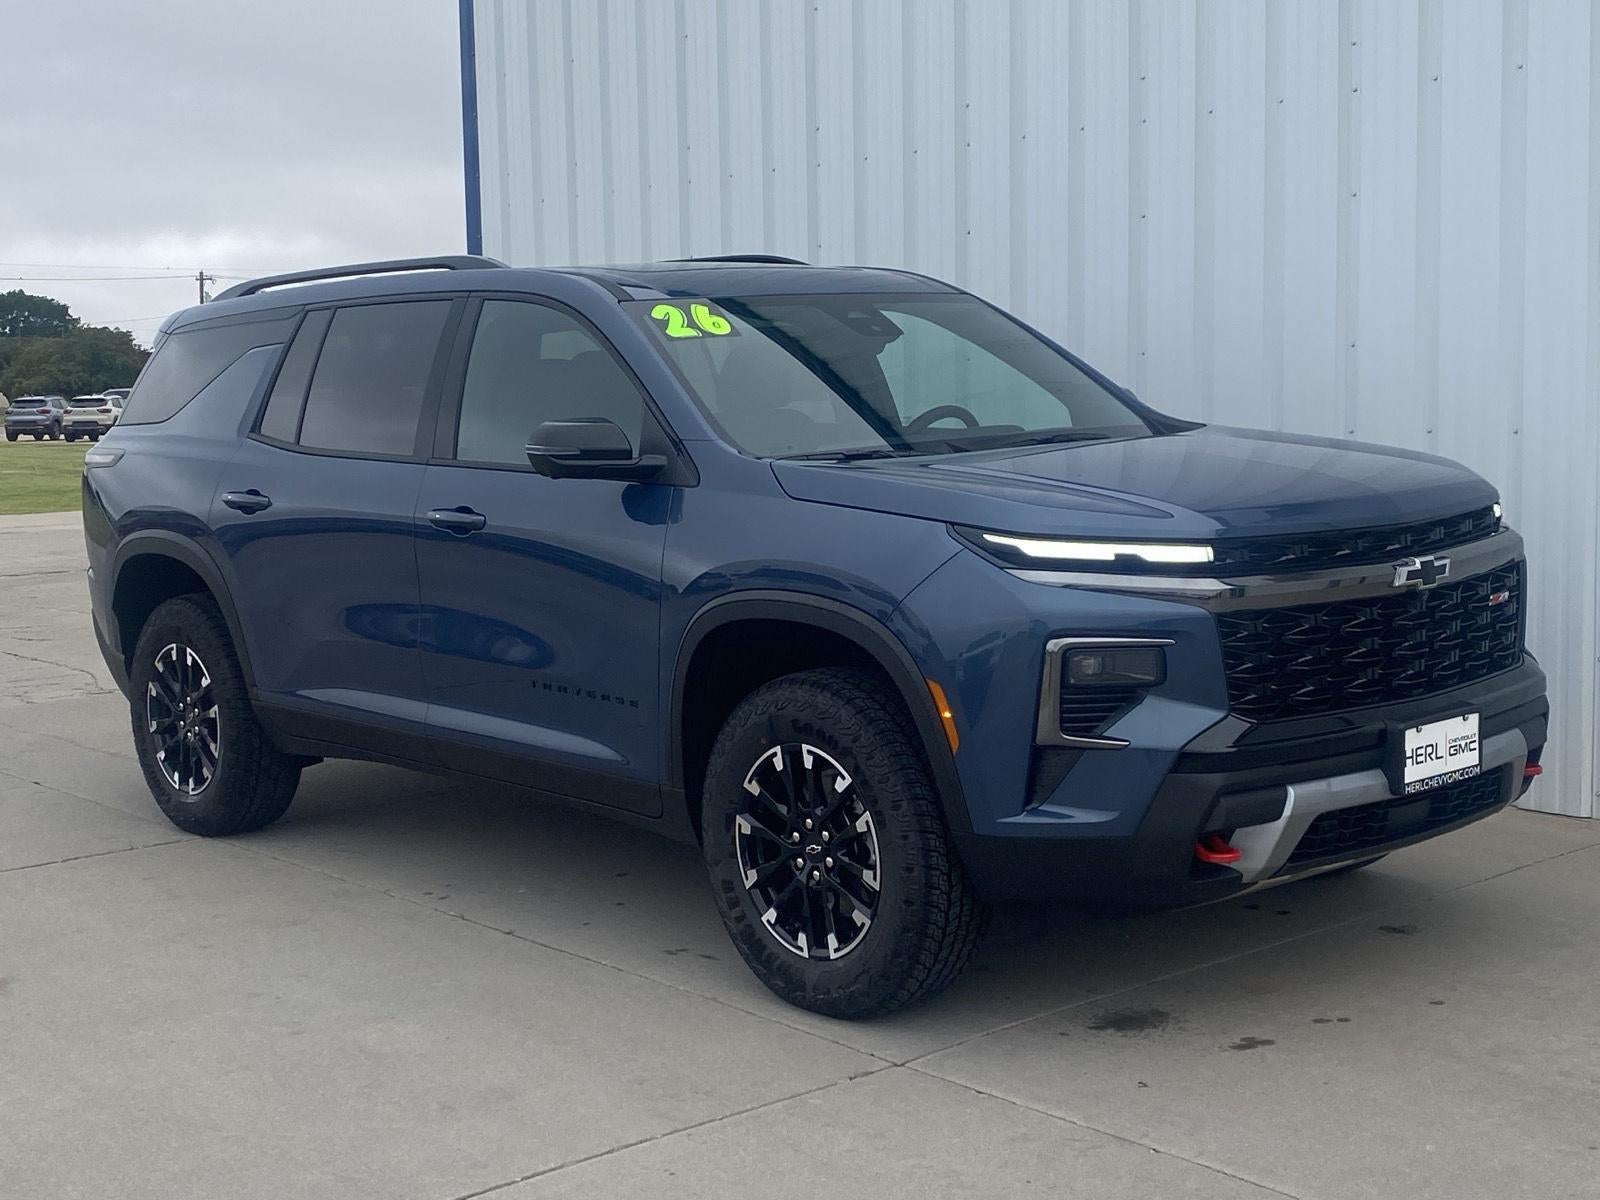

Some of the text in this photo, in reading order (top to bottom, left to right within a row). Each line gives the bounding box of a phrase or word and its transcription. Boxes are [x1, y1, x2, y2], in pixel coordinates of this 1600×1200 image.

[650, 303, 732, 338] 26
[1448, 732, 1477, 745] CHEVROLET
[1448, 739, 1477, 757] GMC
[1404, 742, 1444, 766] HERL
[1405, 765, 1480, 795] HERLCHEVYGMC.COM
